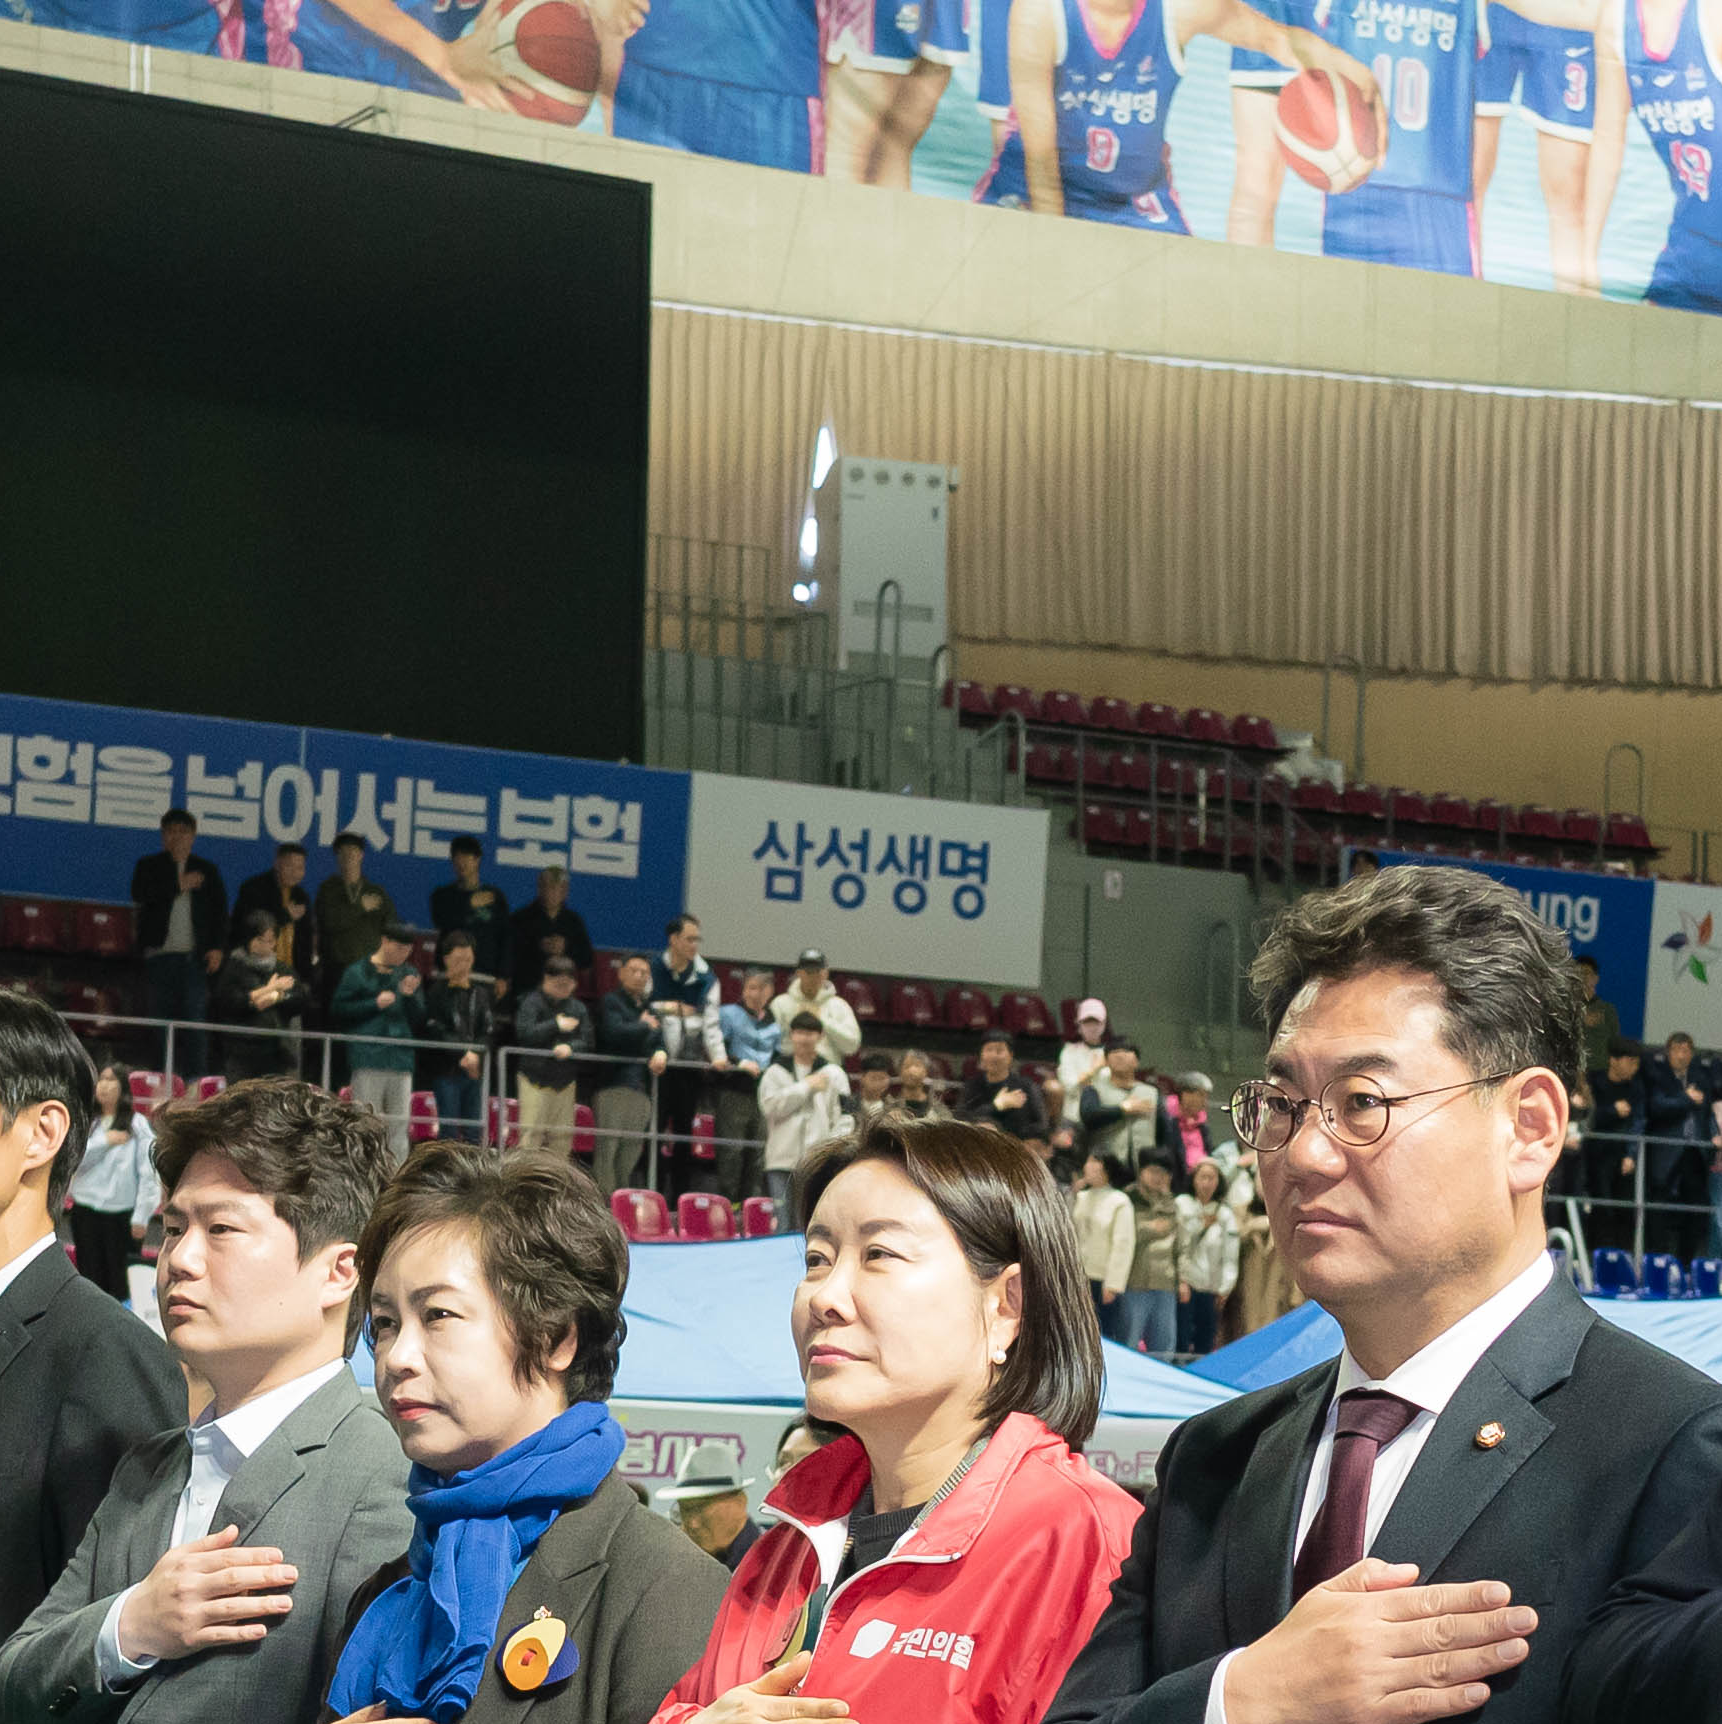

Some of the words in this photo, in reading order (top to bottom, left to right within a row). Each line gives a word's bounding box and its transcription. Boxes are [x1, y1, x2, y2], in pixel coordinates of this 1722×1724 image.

[185, 754, 488, 860] 넘어서는
[495, 787, 643, 879] 보험
[752, 820, 991, 920] 삼성생명
